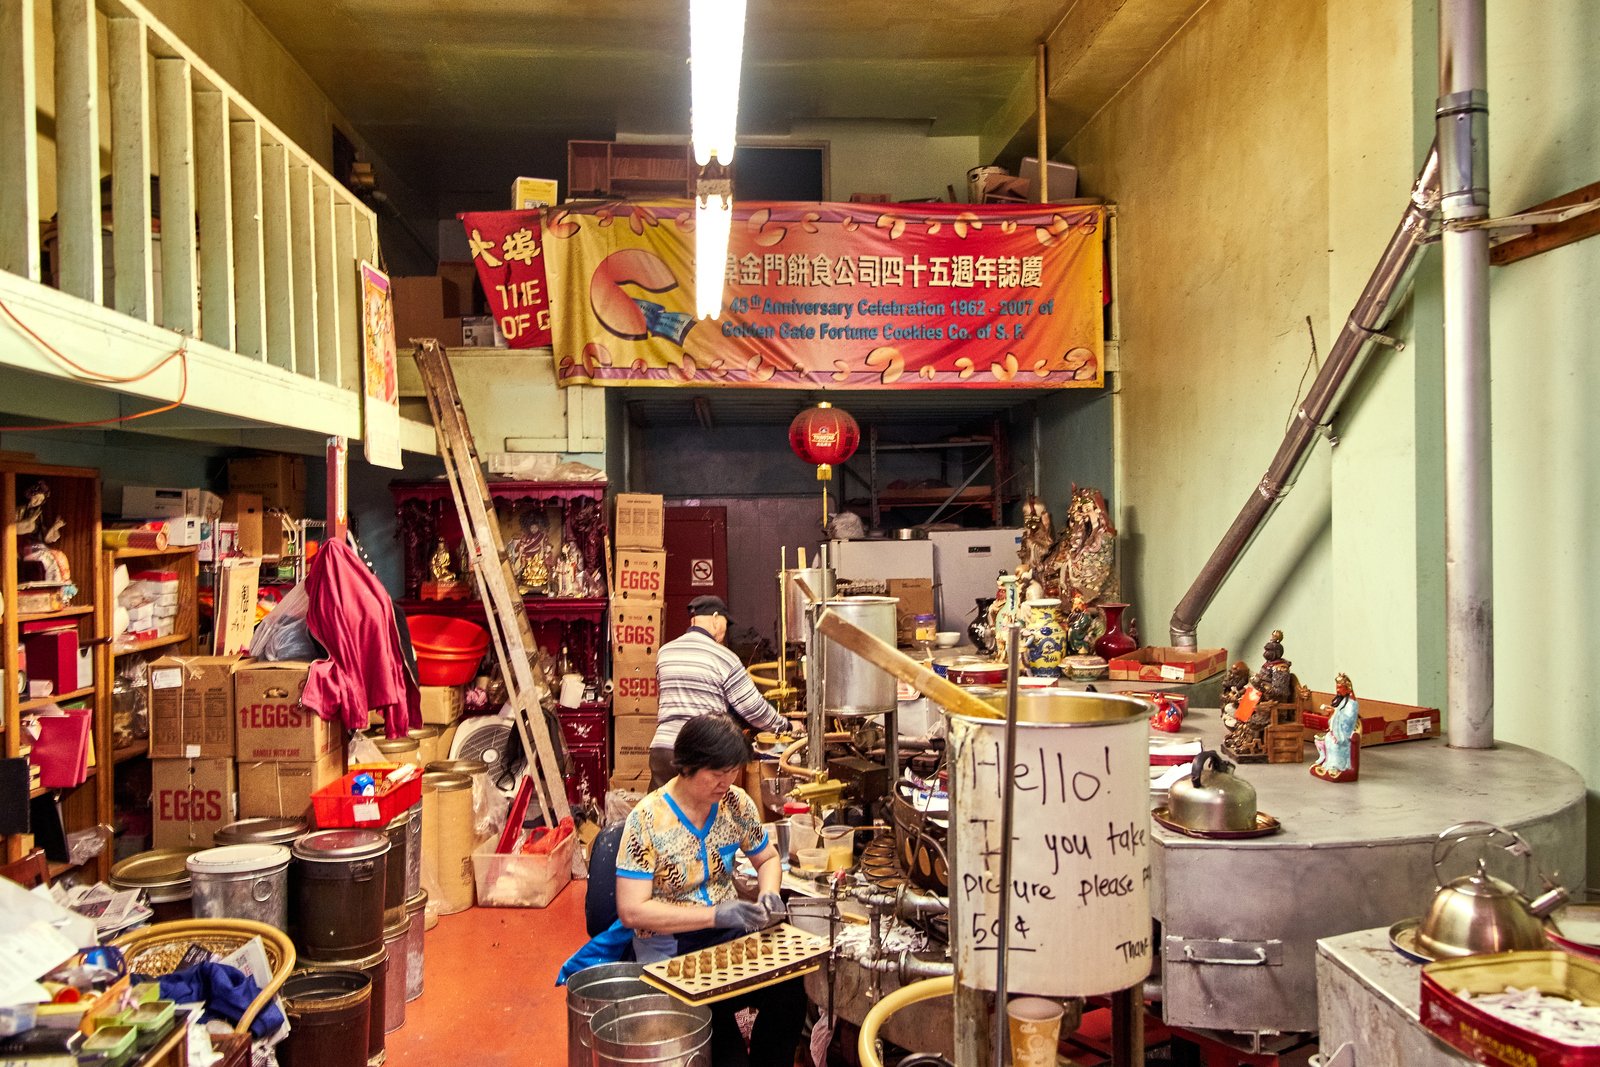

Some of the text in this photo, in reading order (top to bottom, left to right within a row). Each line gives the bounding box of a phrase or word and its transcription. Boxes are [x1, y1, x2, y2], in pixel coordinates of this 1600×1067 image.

[763, 298, 853, 320] Anniversary
[858, 299, 945, 316] Celebration
[951, 301, 985, 316] 1962
[1000, 300, 1034, 315] 2007
[1038, 298, 1054, 315] of
[501, 314, 530, 340] OF
[722, 321, 1025, 340] Golden Gate Fortune Cookies Co. of S. F.
[621, 570, 660, 590] EGGS
[616, 625, 655, 645] EGGS
[619, 677, 658, 697] EGGS
[251, 704, 302, 729] EGGS
[970, 739, 1113, 805] Hello!
[159, 789, 222, 822] EGGS
[968, 818, 1147, 876] I you take
[963, 872, 1057, 902] picure
[1078, 873, 1135, 907] please
